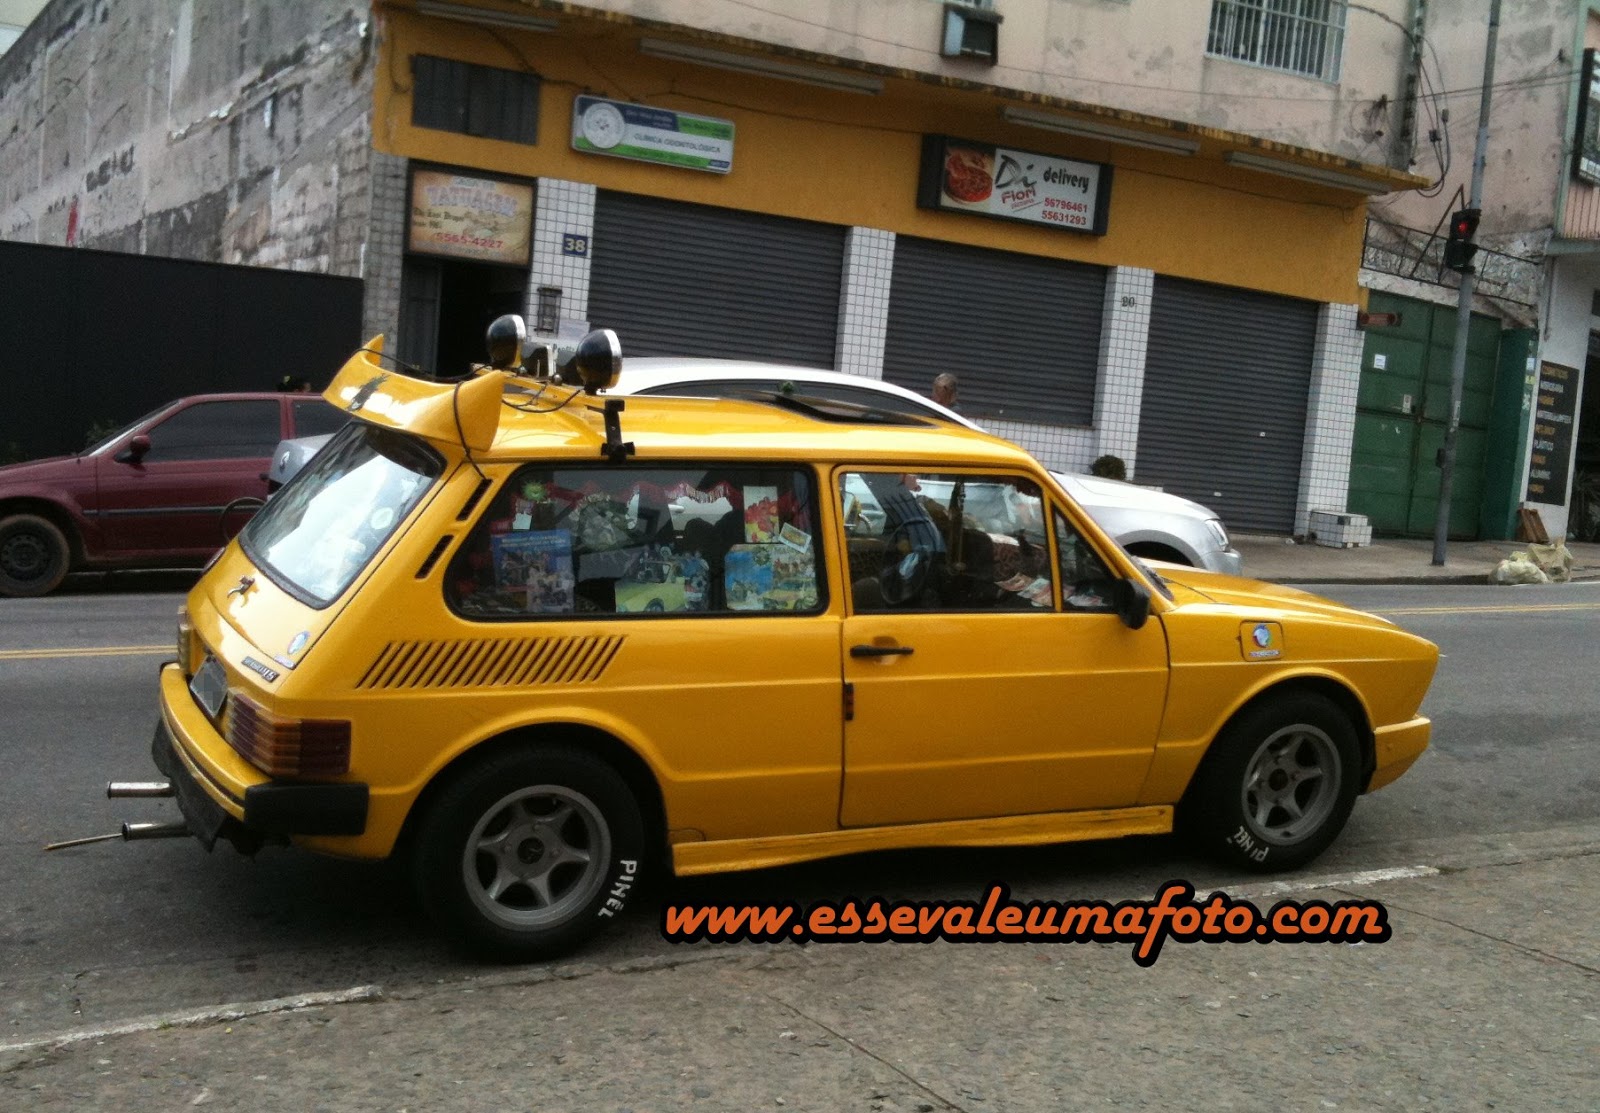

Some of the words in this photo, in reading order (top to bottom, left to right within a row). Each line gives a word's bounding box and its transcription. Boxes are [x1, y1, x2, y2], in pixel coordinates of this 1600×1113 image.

[995, 154, 1037, 188] Di
[1043, 167, 1090, 192] delivery
[1044, 197, 1088, 213] 56796461
[1042, 210, 1087, 225] 55631293
[564, 237, 587, 253] 38
